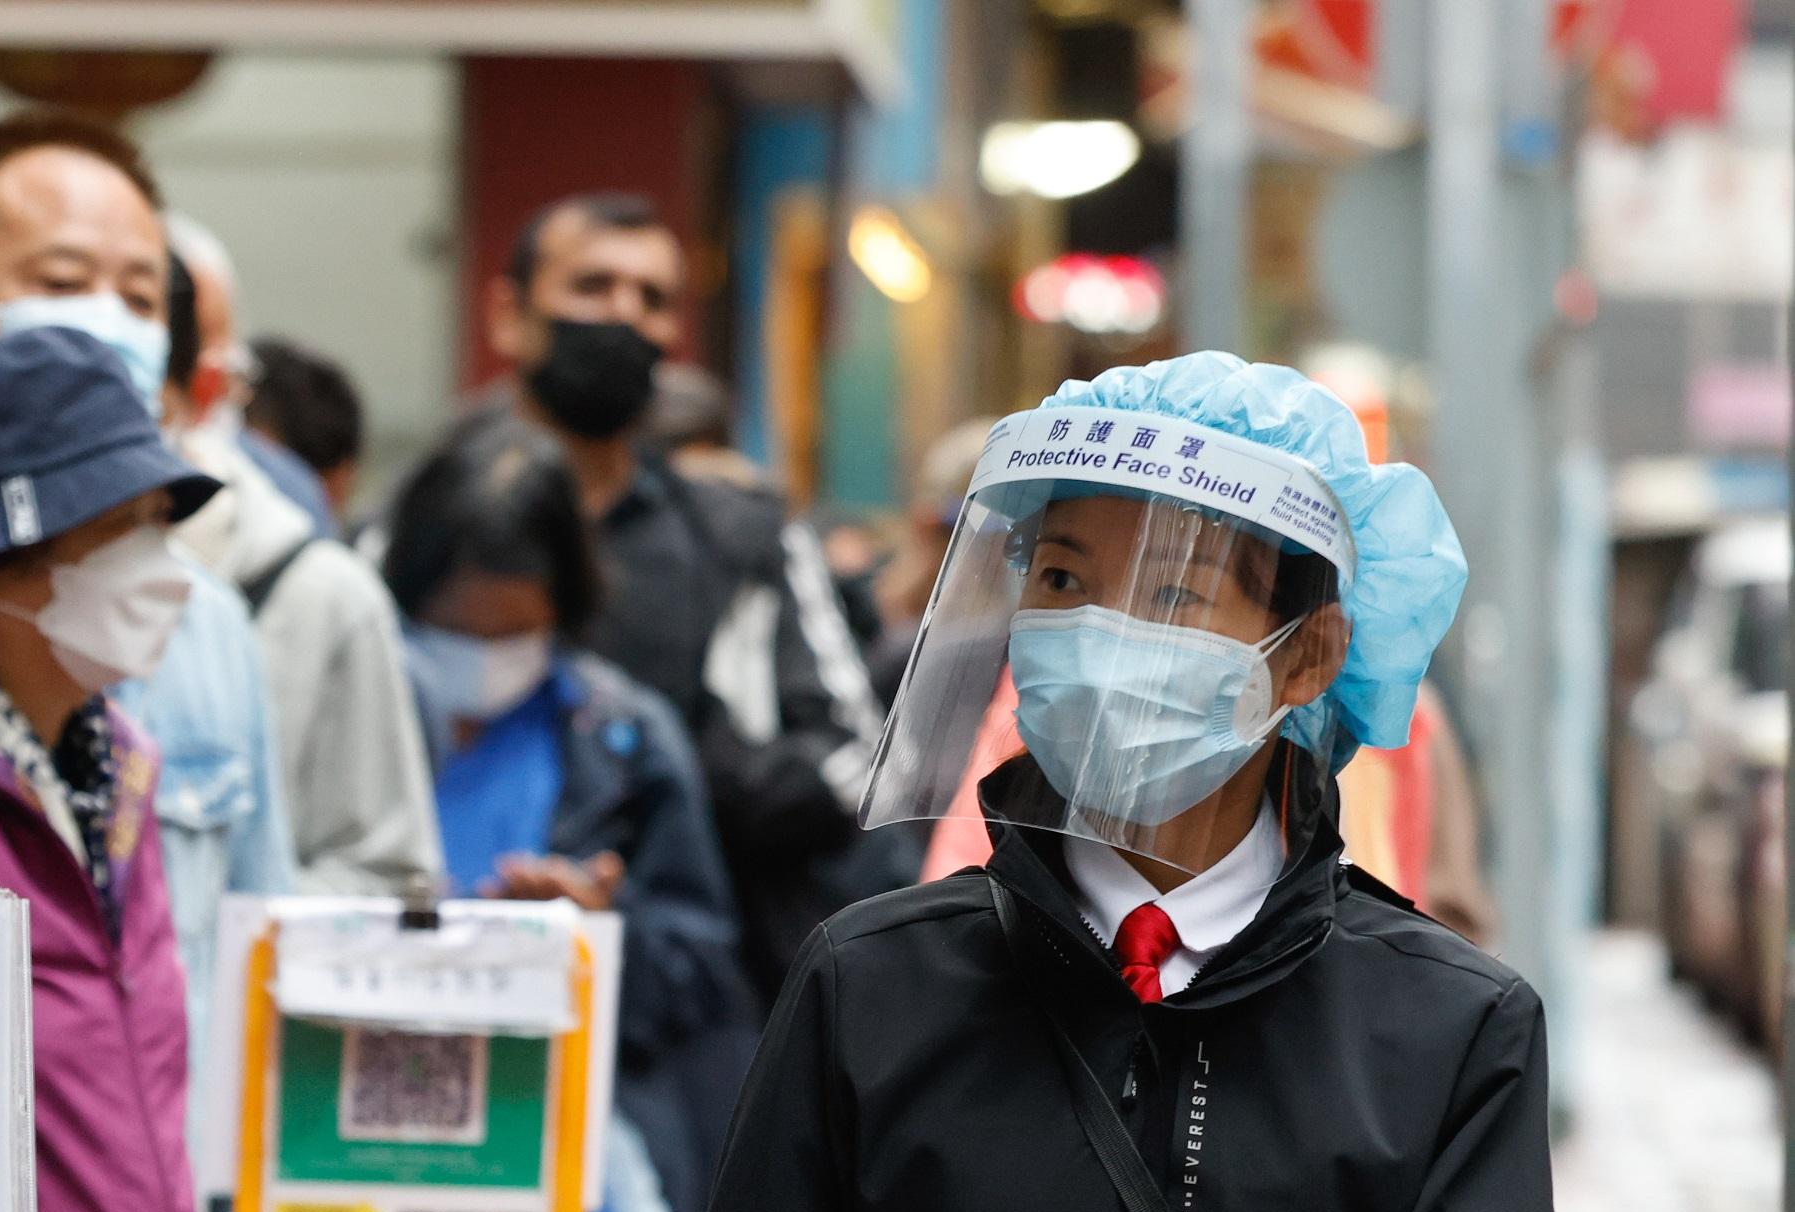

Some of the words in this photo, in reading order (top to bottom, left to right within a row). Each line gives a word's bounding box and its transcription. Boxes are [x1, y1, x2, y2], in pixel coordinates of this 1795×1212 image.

[1046, 418, 1206, 461] 防護面罩
[1006, 446, 1107, 470] Protective
[1112, 454, 1172, 480] Face
[1179, 466, 1258, 505] Shield
[1269, 506, 1293, 522] fluid
[1293, 518, 1333, 547] splashing
[1275, 497, 1309, 519] Protect
[1183, 1080, 1209, 1185] EVEREST
